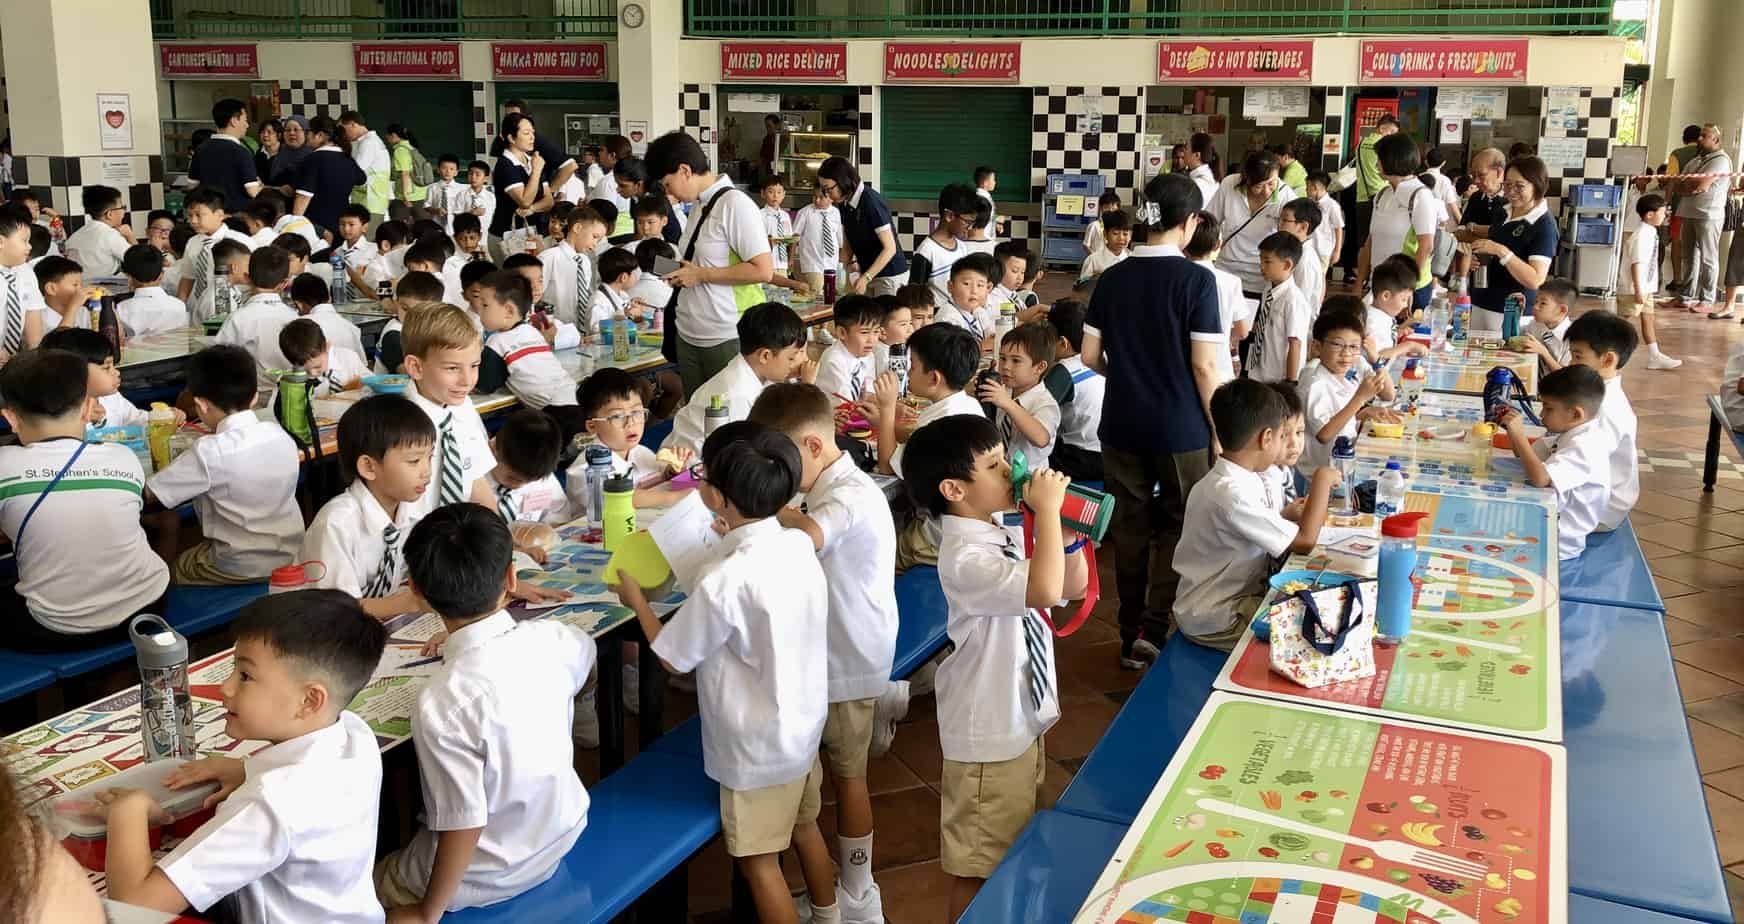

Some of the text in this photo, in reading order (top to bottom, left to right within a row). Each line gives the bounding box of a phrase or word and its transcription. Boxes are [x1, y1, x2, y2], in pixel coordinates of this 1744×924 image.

[360, 51, 455, 66] INTERNATIONAL FOOD
[500, 52, 599, 68] HAKKA YONG TAU FOO
[728, 52, 840, 70] MIXED RICE DELIGHT
[894, 52, 1014, 70] NOODLES DELIGHTS
[1217, 51, 1225, 69] &
[1226, 50, 1246, 69] HOT
[1247, 50, 1304, 70] BEVERAGES
[1372, 51, 1517, 71] COLD DRINKS & FRESH FRUITS
[25, 469, 41, 479] St.
[103, 468, 134, 480] School
